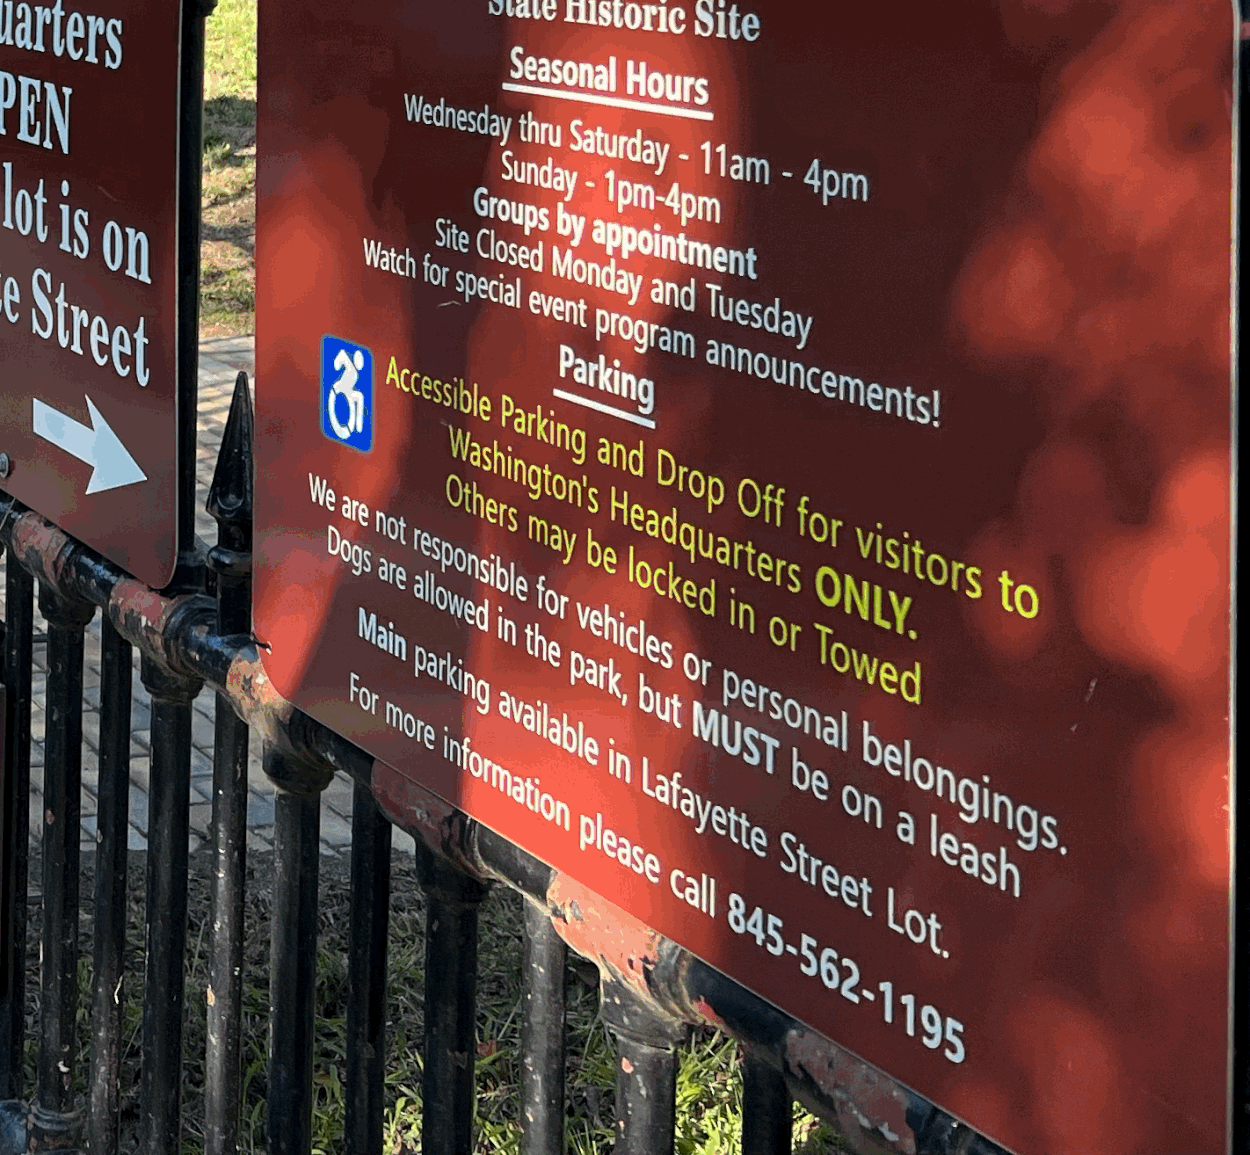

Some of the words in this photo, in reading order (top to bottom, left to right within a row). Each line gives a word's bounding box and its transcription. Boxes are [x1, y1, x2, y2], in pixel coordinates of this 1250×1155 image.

[403, 93, 512, 146] Wednesday
[518, 112, 562, 147] thru
[569, 119, 670, 175] Saturday
[700, 140, 771, 185] 11am
[803, 158, 870, 206] 4pm
[509, 46, 617, 93] Seasonal
[625, 59, 710, 106] Hours
[2, 162, 48, 243] lot
[59, 180, 89, 259] is
[102, 220, 152, 285] on
[473, 187, 550, 236] Groups
[556, 202, 586, 247] by
[591, 218, 758, 280] appointment
[501, 150, 578, 202] Sunday
[604, 169, 722, 227] 1pm-4pm
[30, 267, 150, 388] Street
[362, 237, 417, 279] Watch
[422, 252, 450, 288] for
[455, 269, 521, 310] special
[528, 289, 588, 329] event
[595, 308, 696, 359] program
[705, 338, 941, 428] announcements!
[435, 217, 470, 254] Site
[476, 228, 544, 273] Closed
[552, 245, 643, 306] Monday
[650, 277, 696, 313] and
[705, 282, 814, 350] Tuesday
[558, 343, 656, 415] Parking
[385, 356, 492, 422] Accessible
[501, 394, 587, 466] Parking
[597, 437, 645, 479] and
[657, 448, 725, 513] Drop
[737, 477, 786, 527] Off
[796, 495, 844, 547] for
[855, 522, 983, 600] visitors
[998, 570, 1040, 619] to
[448, 423, 599, 514] Washington's
[610, 485, 802, 594] Headquarters
[815, 565, 919, 641] ONLY.
[308, 472, 336, 512] We
[341, 493, 370, 527] are
[375, 509, 407, 546] not
[413, 526, 529, 603] responsible
[535, 575, 569, 620] for
[576, 601, 674, 670] vehicles
[682, 651, 713, 687] or
[722, 667, 848, 753] personal
[862, 720, 1068, 856] belongings.
[445, 473, 518, 533] Others
[528, 513, 578, 566] may
[586, 527, 618, 575] be
[628, 545, 716, 617] locked
[729, 586, 755, 634] in
[769, 615, 802, 652] or
[813, 621, 922, 705] Towed
[327, 524, 373, 577] Dogs
[378, 554, 408, 591] are
[413, 570, 490, 633] allowed
[497, 605, 518, 647] in
[524, 621, 561, 668] the
[569, 649, 628, 707] park,
[638, 673, 683, 729] but
[691, 700, 780, 775] MUST
[791, 746, 830, 801] be
[841, 783, 883, 829] on
[896, 810, 916, 845] a
[929, 813, 1021, 898] leash
[357, 605, 408, 662] Main
[414, 643, 491, 715] parking
[498, 690, 600, 766] available
[608, 738, 632, 784] in
[641, 755, 769, 858] Lafayette
[779, 831, 873, 917] Street
[887, 886, 950, 959] Lot.
[349, 671, 380, 716] For
[385, 699, 436, 750] more
[442, 726, 570, 832] information
[579, 812, 660, 884] please
[669, 866, 716, 919] call
[727, 892, 967, 1064] 845-562-1195
